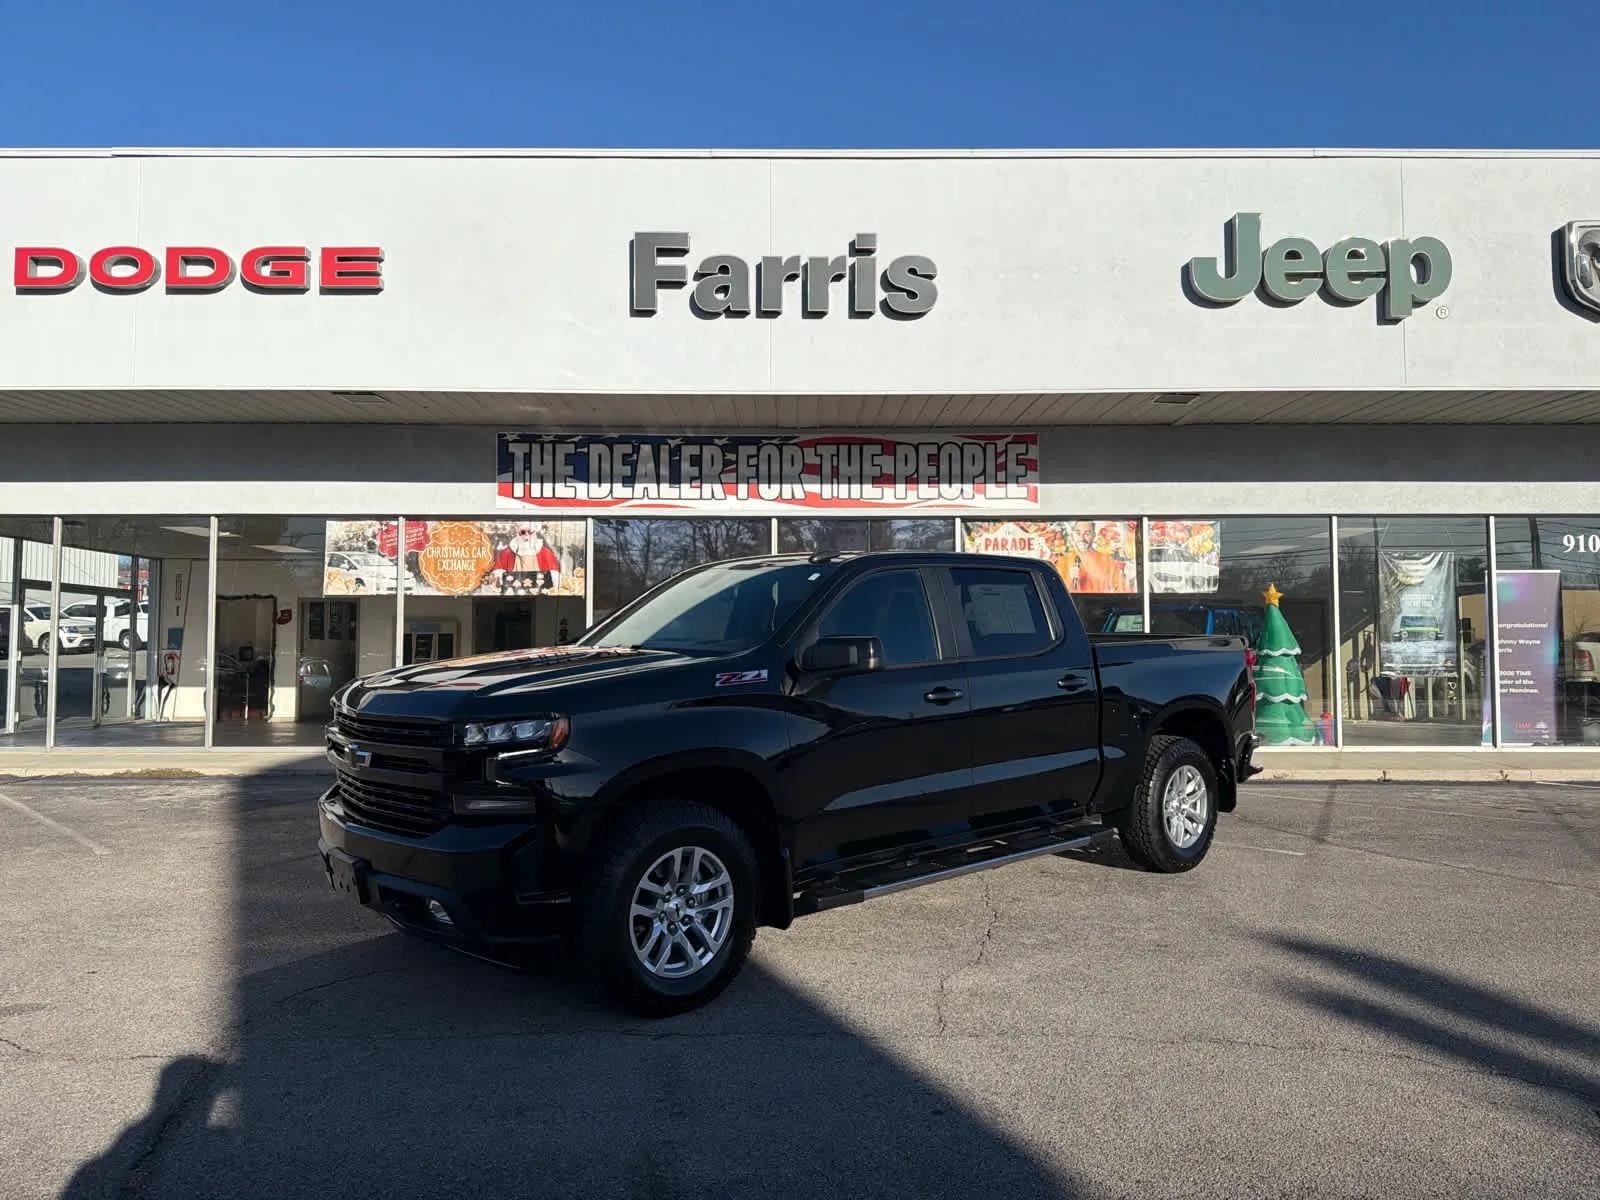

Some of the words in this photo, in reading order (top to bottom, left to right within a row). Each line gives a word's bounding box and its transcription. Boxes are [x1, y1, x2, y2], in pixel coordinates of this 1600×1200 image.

[14, 246, 384, 295] DODGE
[630, 231, 938, 320] Farris
[1181, 212, 1453, 325] Jeep
[508, 442, 578, 499] THE
[587, 442, 727, 500] DEALER
[736, 442, 807, 500] FOR
[814, 442, 884, 500] THE
[894, 442, 1029, 500] PEOPLE
[426, 547, 470, 558] CHRISTMAS
[471, 547, 487, 558] CAR
[984, 537, 1035, 551] PARADE
[1562, 534, 1600, 553] 910
[437, 560, 477, 571] EXCHANGE
[715, 669, 768, 687] Z71
